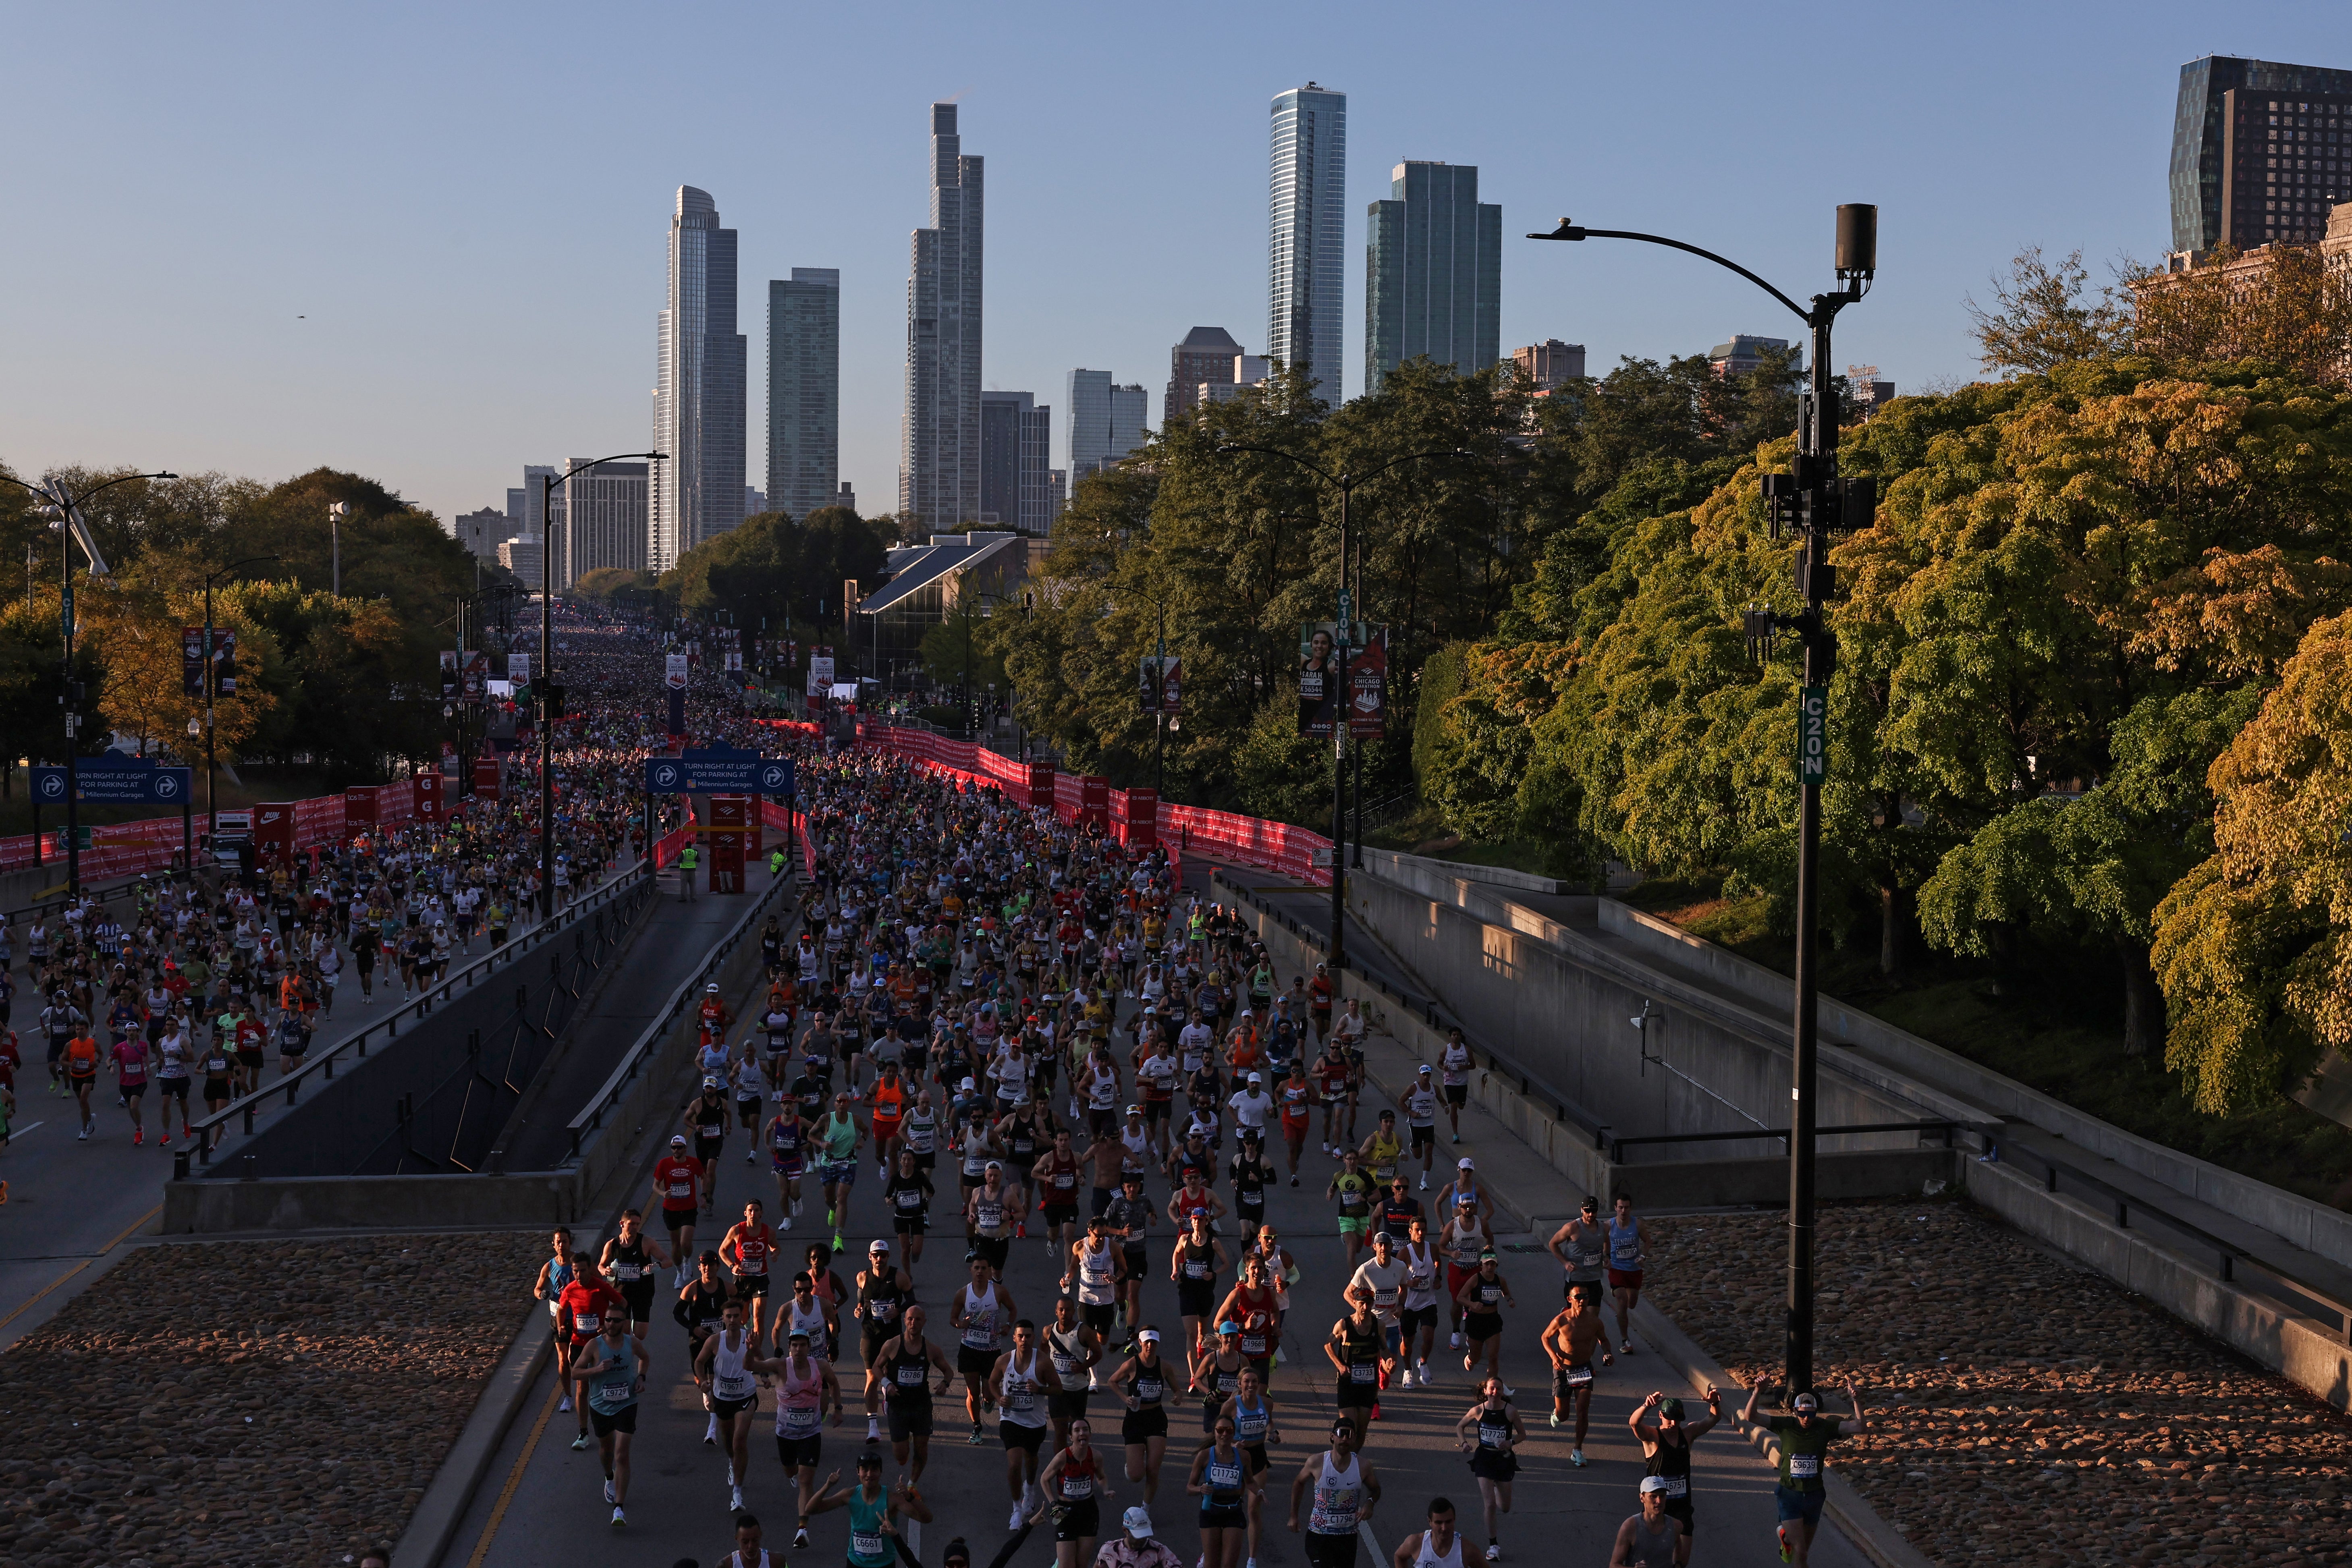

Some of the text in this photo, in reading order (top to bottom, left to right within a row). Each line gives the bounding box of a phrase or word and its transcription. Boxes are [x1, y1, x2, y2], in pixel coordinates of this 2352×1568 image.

[1853, 389, 1875, 401] Travelodge
[62, 598, 71, 626] C11
[1339, 594, 1349, 640] C10N
[1806, 697, 1823, 774] C20N
[1481, 1431, 1505, 1439] C17720
[1794, 1460, 1815, 1468] C9639
[1212, 1469, 1237, 1478] C11732
[1065, 1482, 1090, 1490] C11722
[1665, 1481, 1685, 1489] 16751
[1331, 1515, 1353, 1523] C1796
[856, 1540, 878, 1548] C6661
